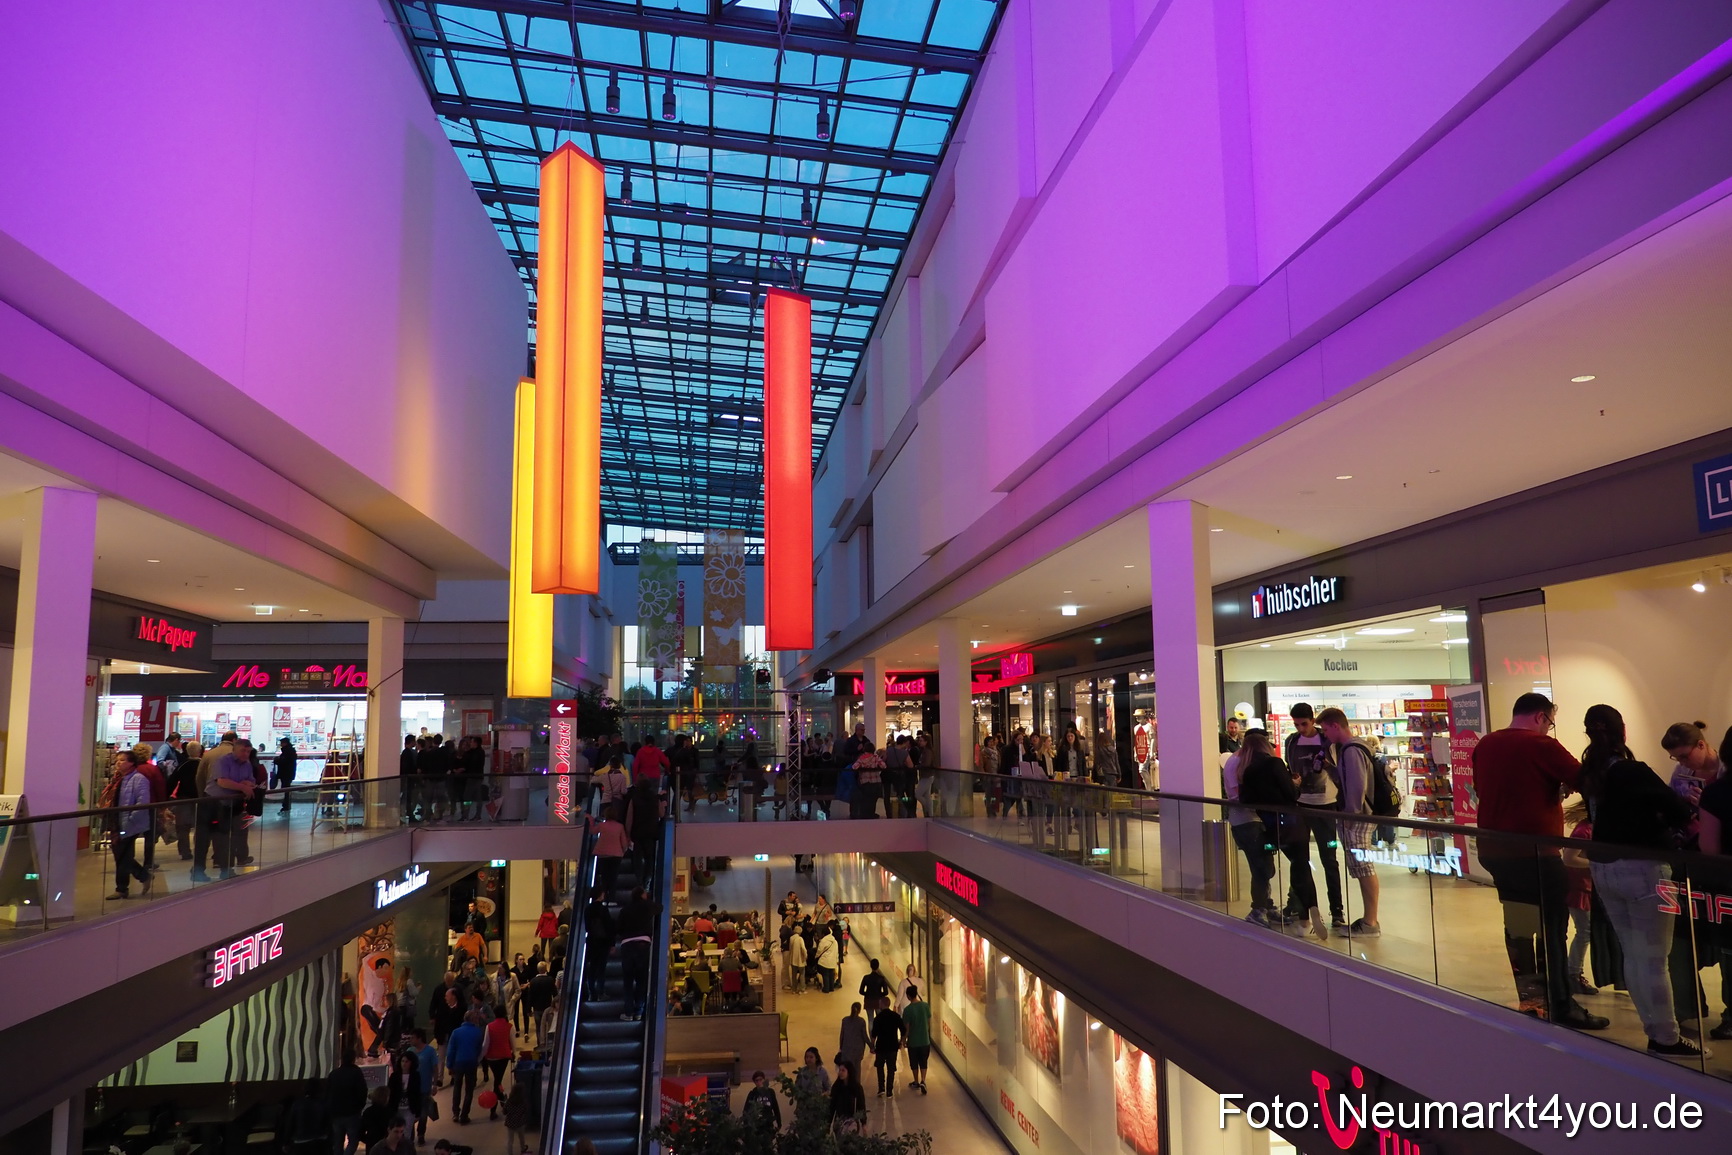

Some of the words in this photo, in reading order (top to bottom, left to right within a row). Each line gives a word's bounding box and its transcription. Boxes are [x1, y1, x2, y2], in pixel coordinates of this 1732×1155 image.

[1715, 479, 1732, 504] L
[1266, 576, 1337, 615] hübscher
[138, 616, 197, 652] McPaper
[1324, 659, 1358, 671] Kochen
[1000, 1088, 1015, 1120] REWE
[1017, 1109, 1040, 1149] CENTER
